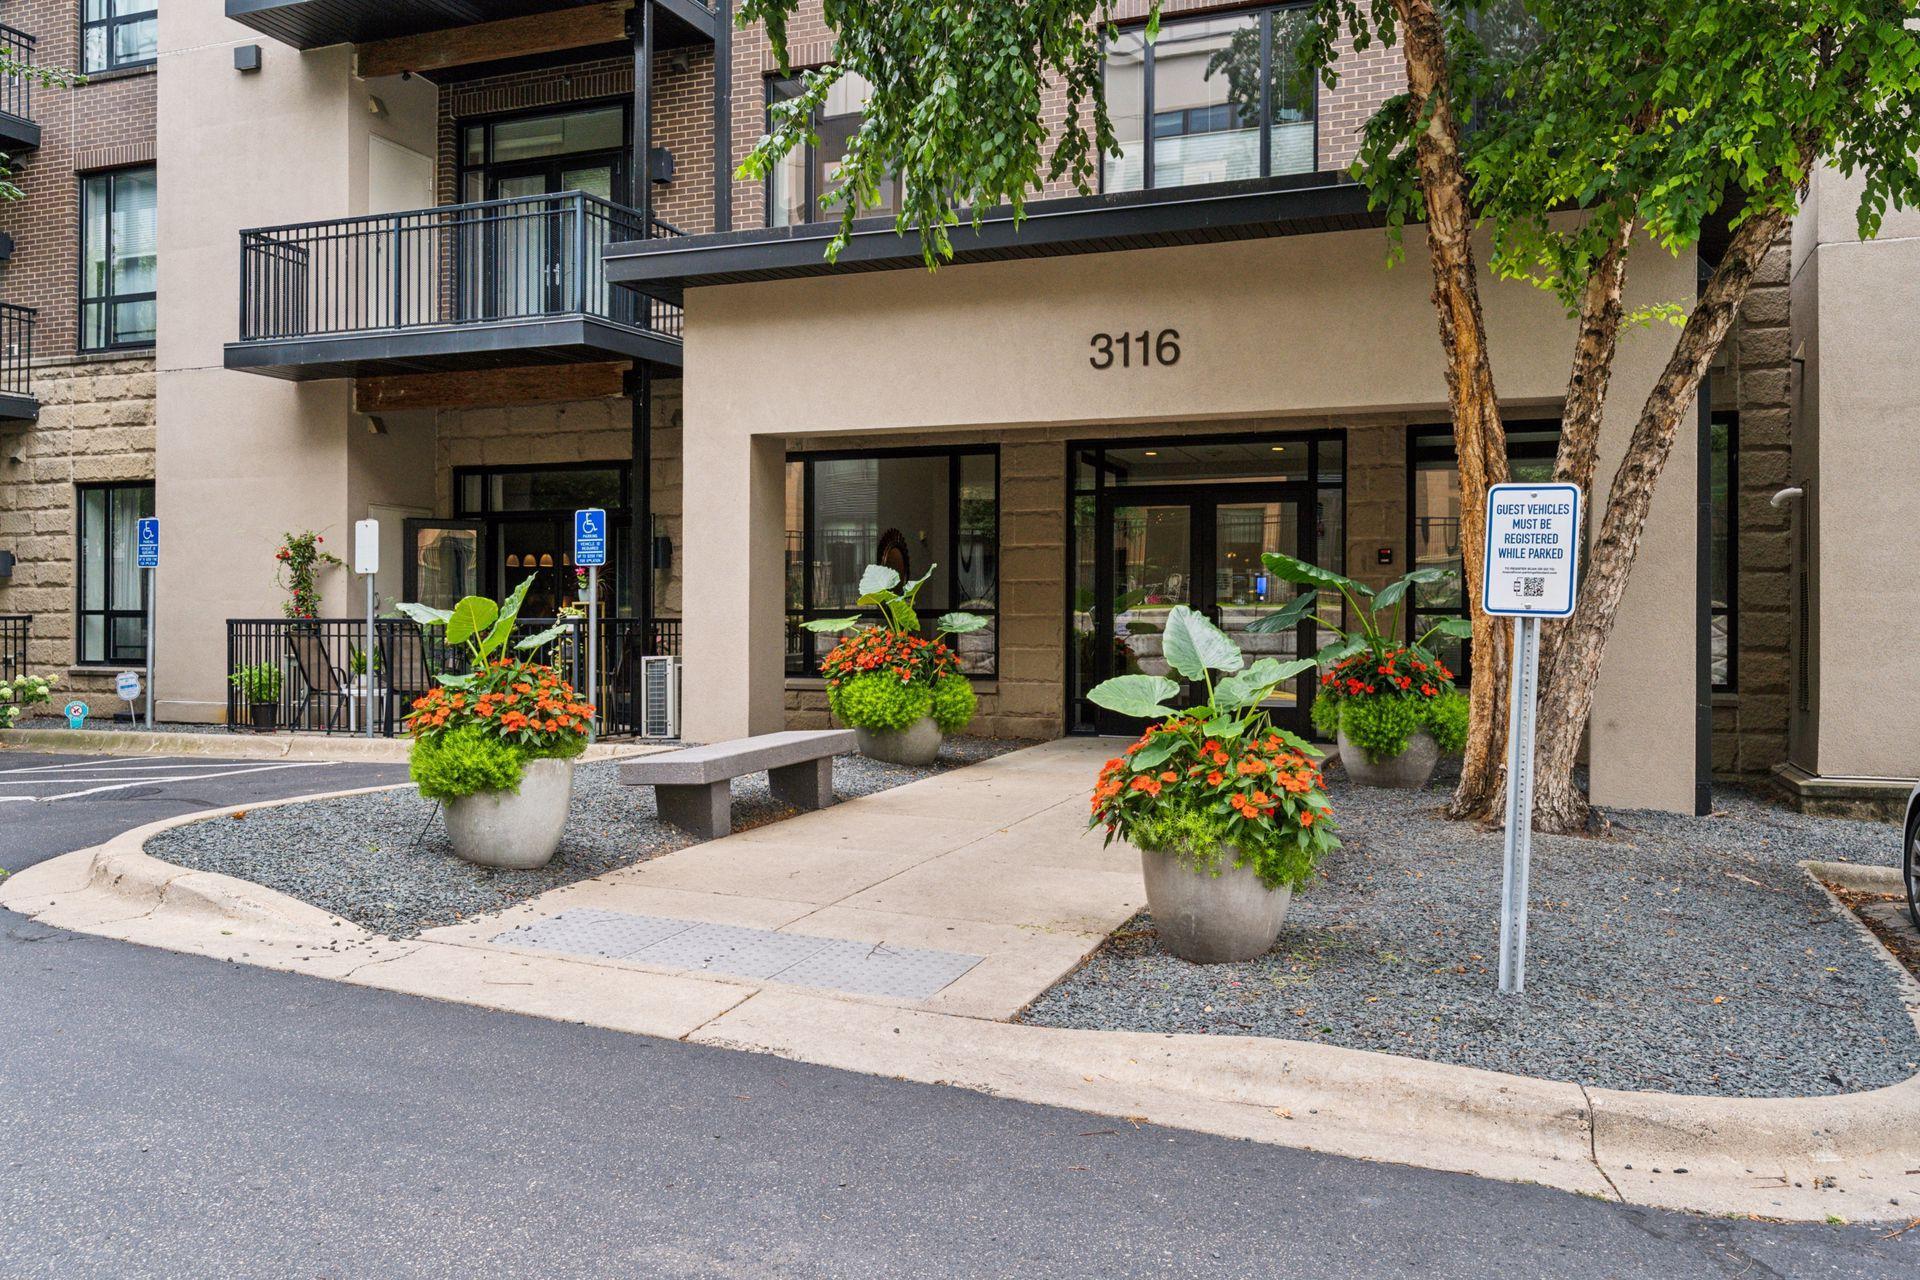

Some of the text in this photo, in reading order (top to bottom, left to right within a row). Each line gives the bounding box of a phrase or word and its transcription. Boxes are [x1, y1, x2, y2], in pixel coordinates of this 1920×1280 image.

[1090, 329, 1180, 370] 3116
[1496, 503, 1570, 515] GUEST VEHICLES
[1512, 518, 1552, 530] MUST BE
[1504, 533, 1559, 545] REGISTERED
[1498, 547, 1564, 559] WHILE PARKED
